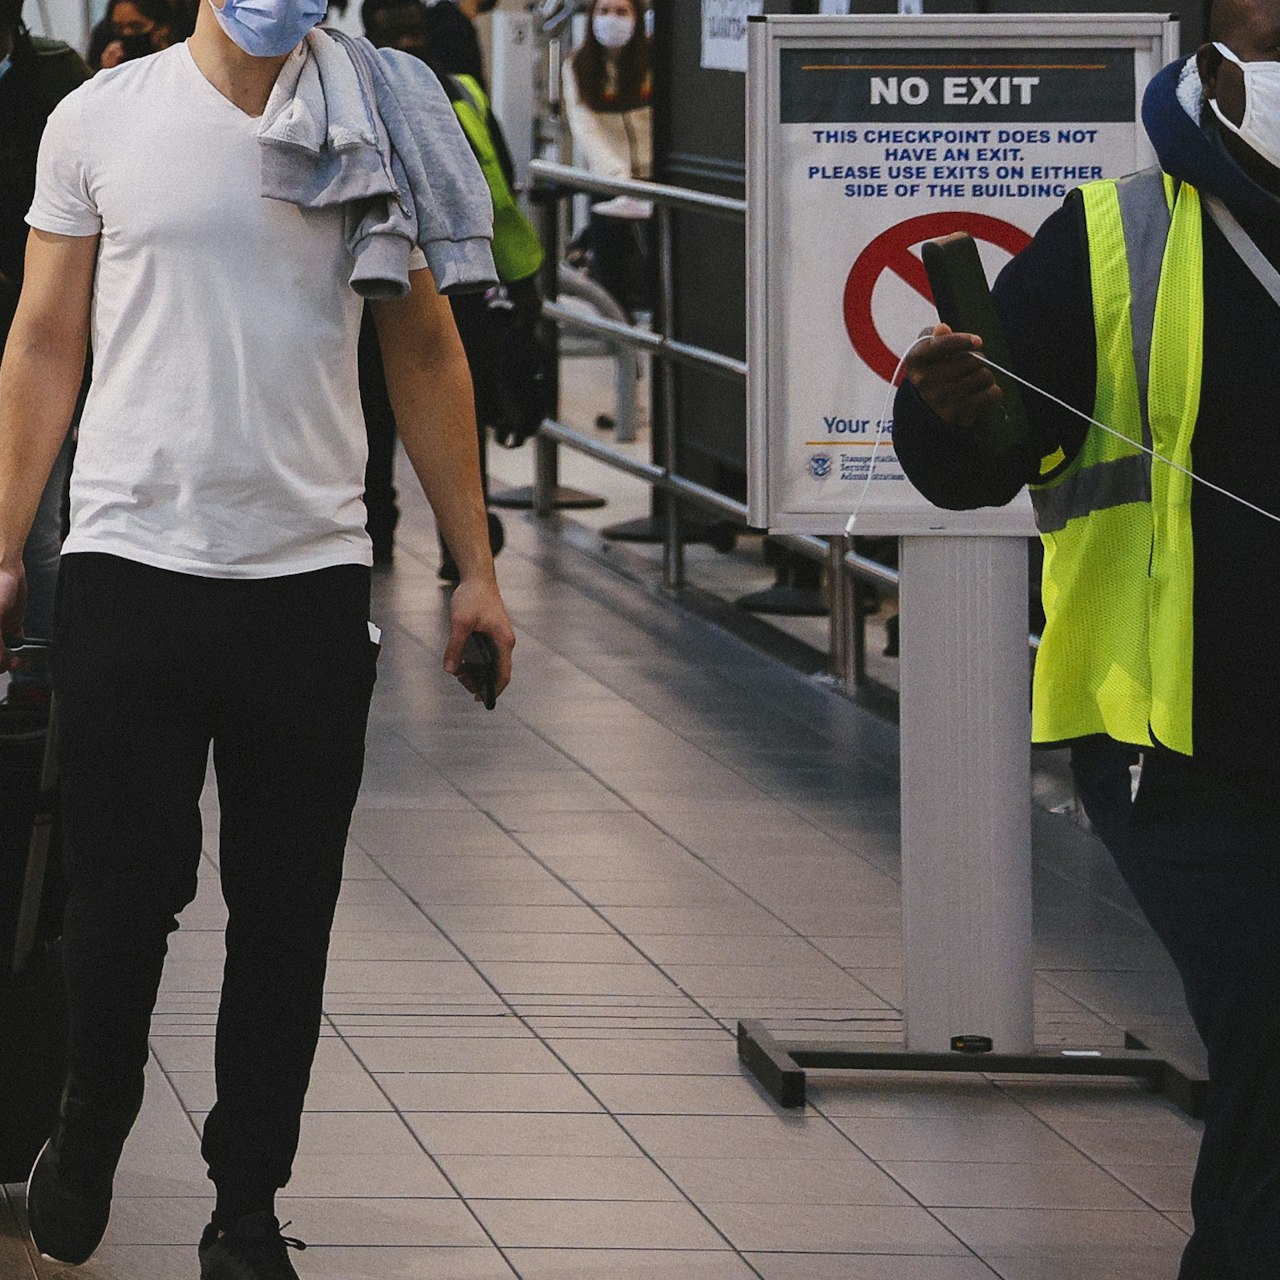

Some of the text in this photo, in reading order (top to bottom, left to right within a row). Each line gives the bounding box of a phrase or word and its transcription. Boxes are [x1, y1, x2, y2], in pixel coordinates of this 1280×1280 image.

[870, 76, 1040, 105] NO EXIT
[812, 129, 1098, 144] THIS CHECKPOINT DOES NOT
[884, 148, 1024, 162] HAVE AN EXIT.
[808, 165, 1103, 180] PLEASE USE EXITS ON EITHER
[844, 183, 888, 198] SIDE
[894, 183, 920, 198] OF
[926, 184, 965, 198] THE
[823, 416, 870, 434] Your
